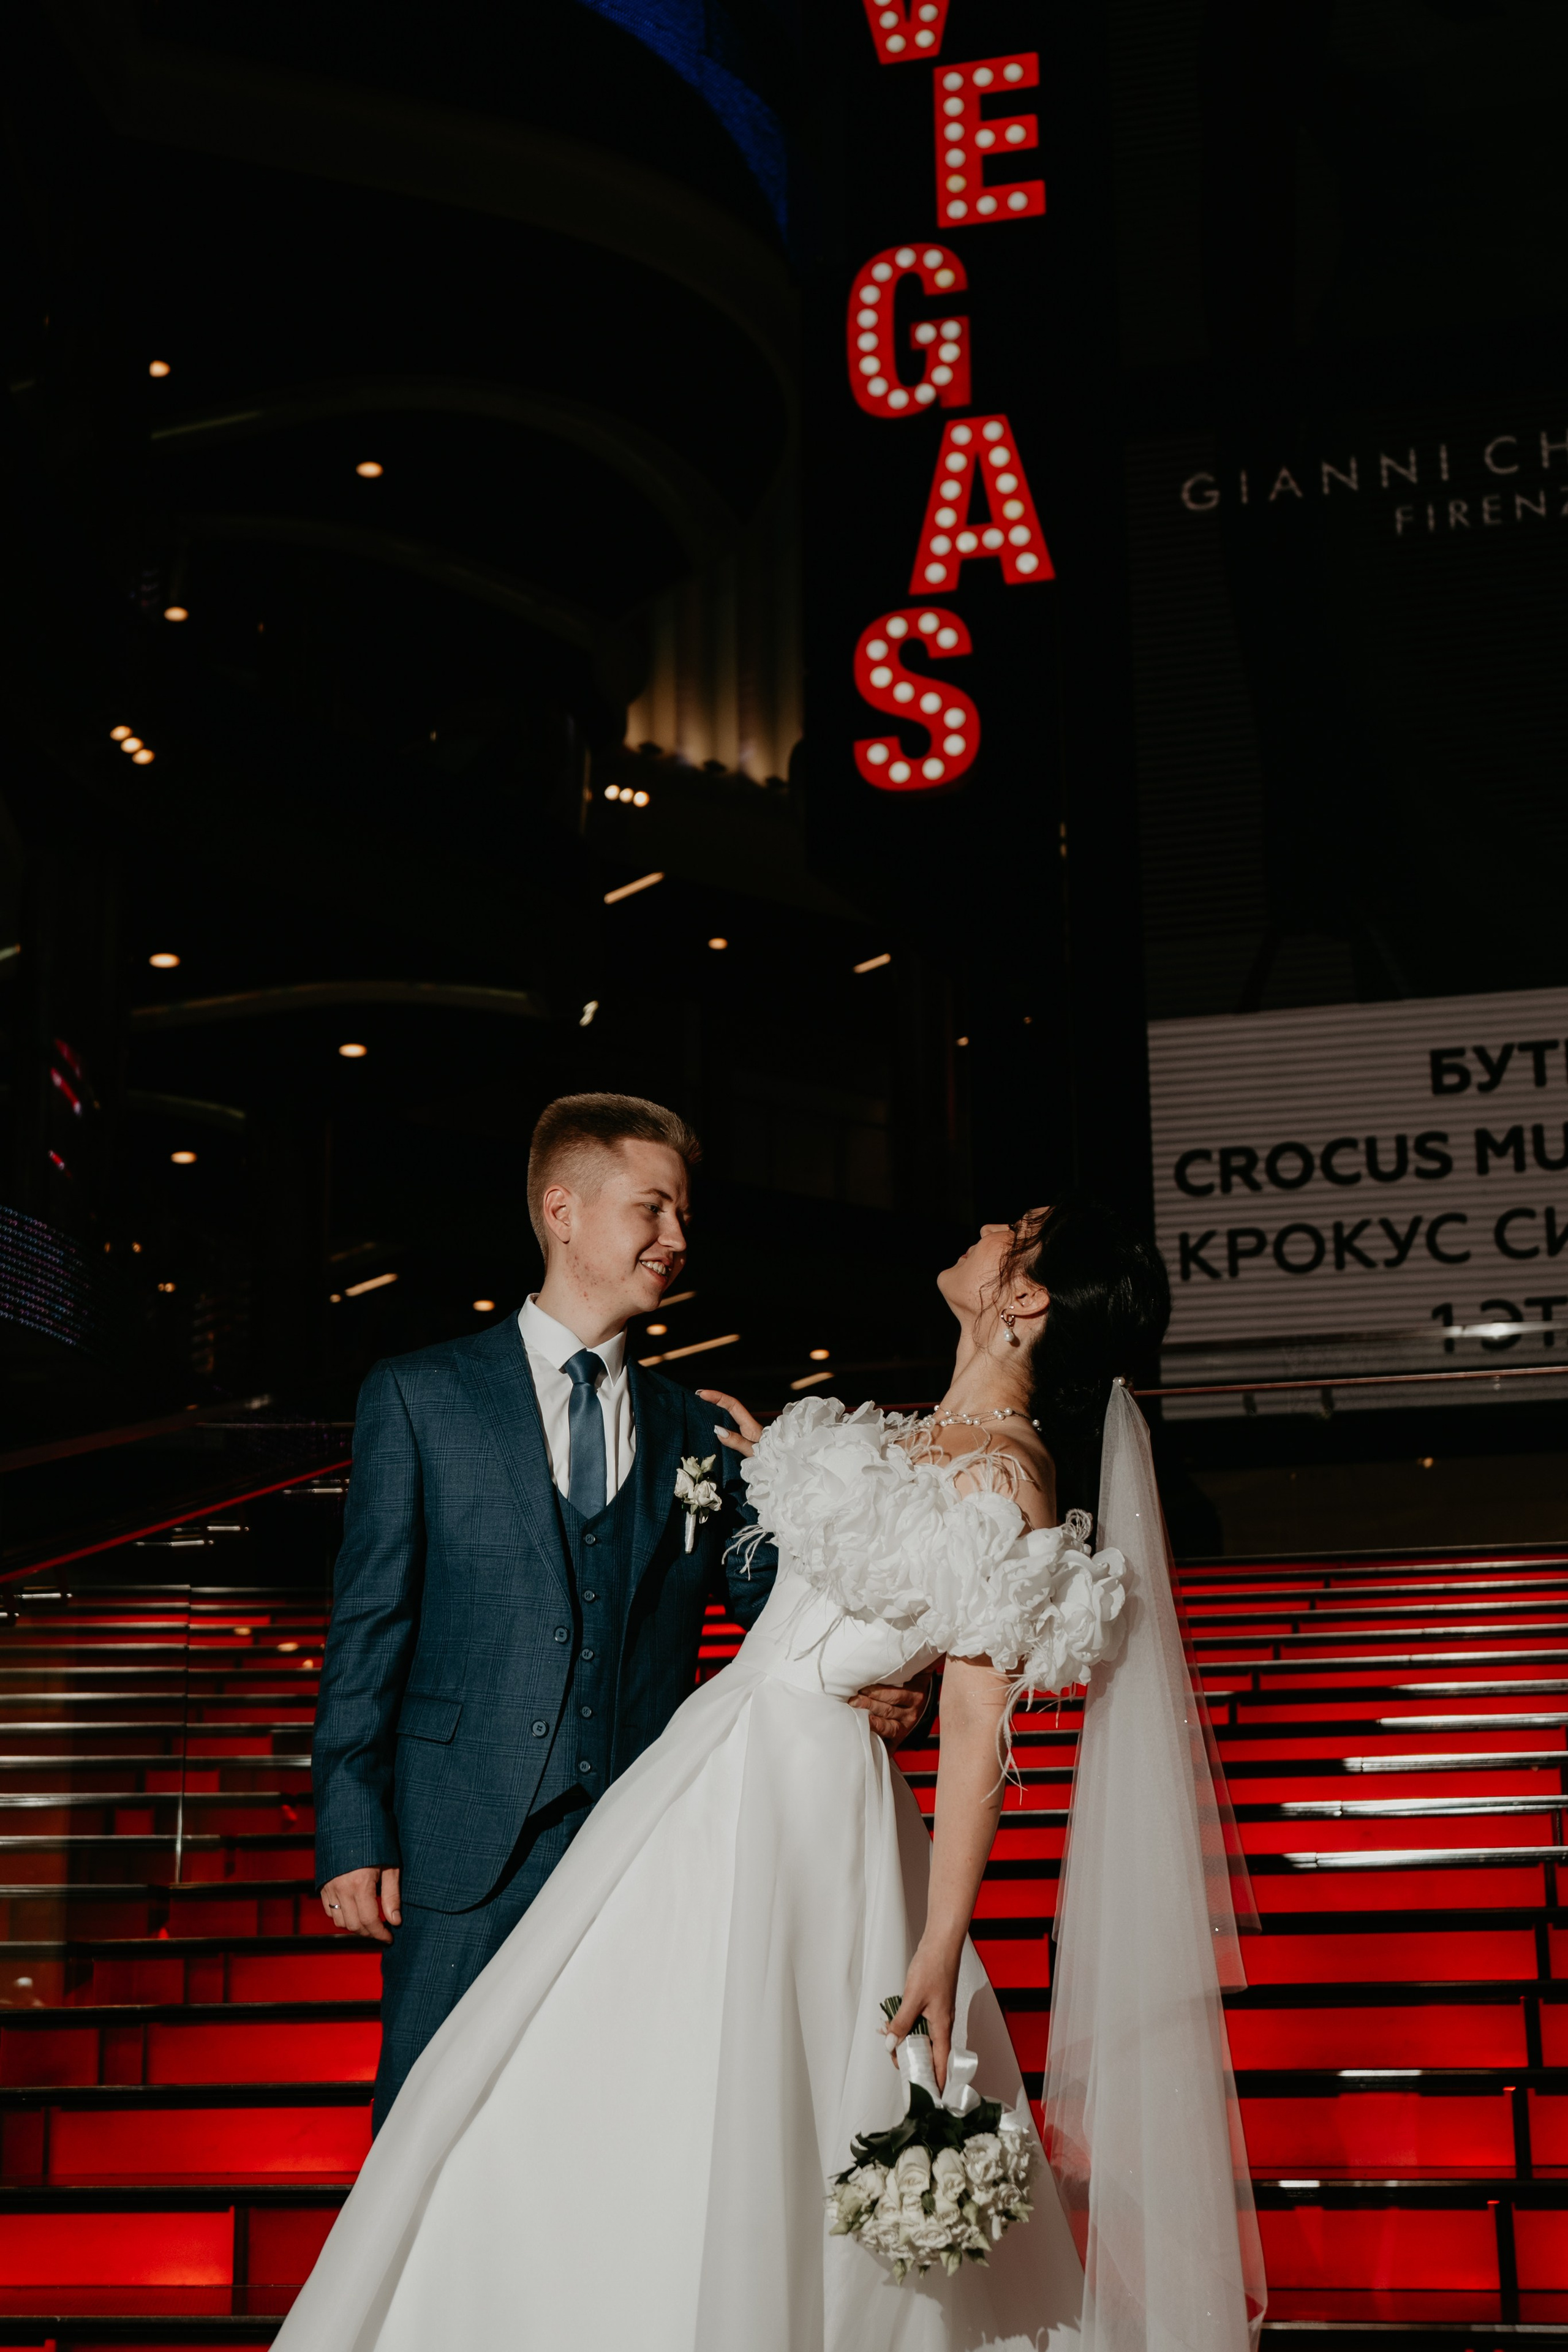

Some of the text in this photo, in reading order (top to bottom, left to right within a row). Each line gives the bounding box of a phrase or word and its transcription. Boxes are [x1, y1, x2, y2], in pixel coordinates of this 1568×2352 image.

[1182, 443, 1449, 511] GIANNI
[1430, 1040, 1568, 1095] БУТ
[1175, 1131, 1453, 1196] CROCUS
[1178, 1212, 1471, 1281] КРОКУС
